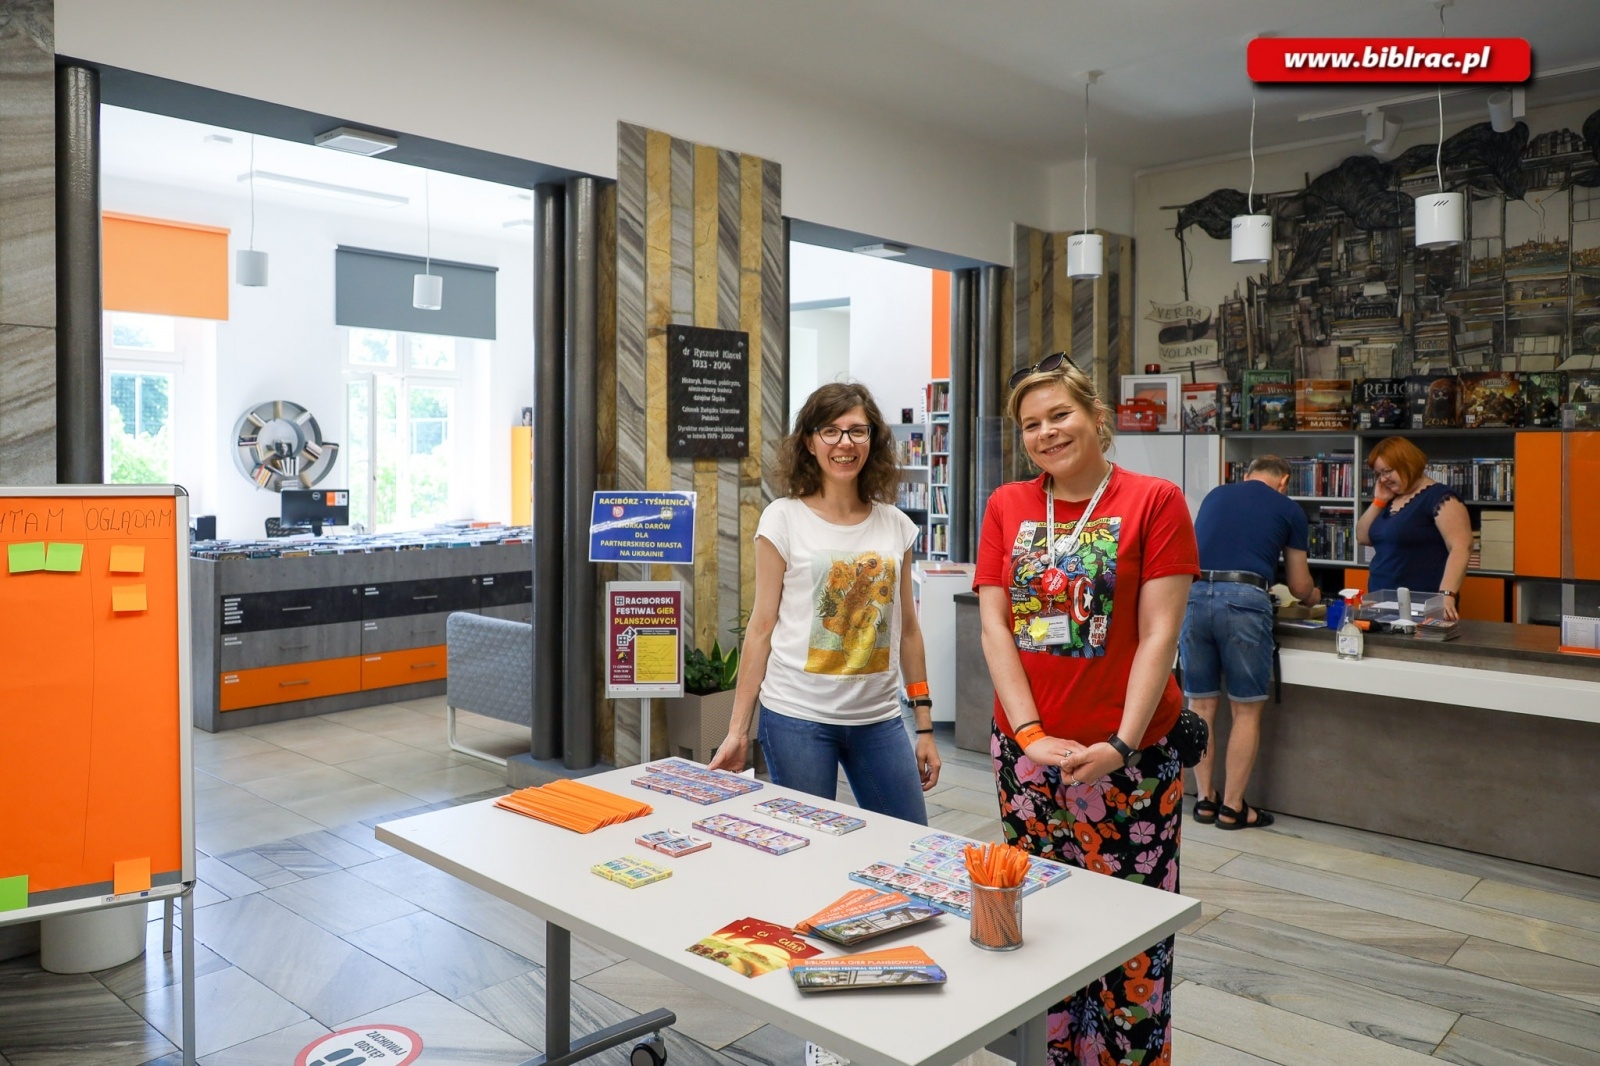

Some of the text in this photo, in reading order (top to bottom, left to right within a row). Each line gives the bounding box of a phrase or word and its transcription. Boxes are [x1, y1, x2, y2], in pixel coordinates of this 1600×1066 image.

[1158, 306, 1202, 319] VERBA
[682, 347, 690, 356] dr
[694, 348, 719, 358] Ryszard
[1160, 345, 1212, 358] VOLANT
[692, 359, 707, 368] 1933
[713, 361, 731, 370] 2004
[645, 498, 689, 506] TYŚMENICA
[779, 938, 803, 952] CATAN
[354, 1041, 385, 1059] ODSTĘP
[366, 1031, 408, 1056] ZACHOWAJ
